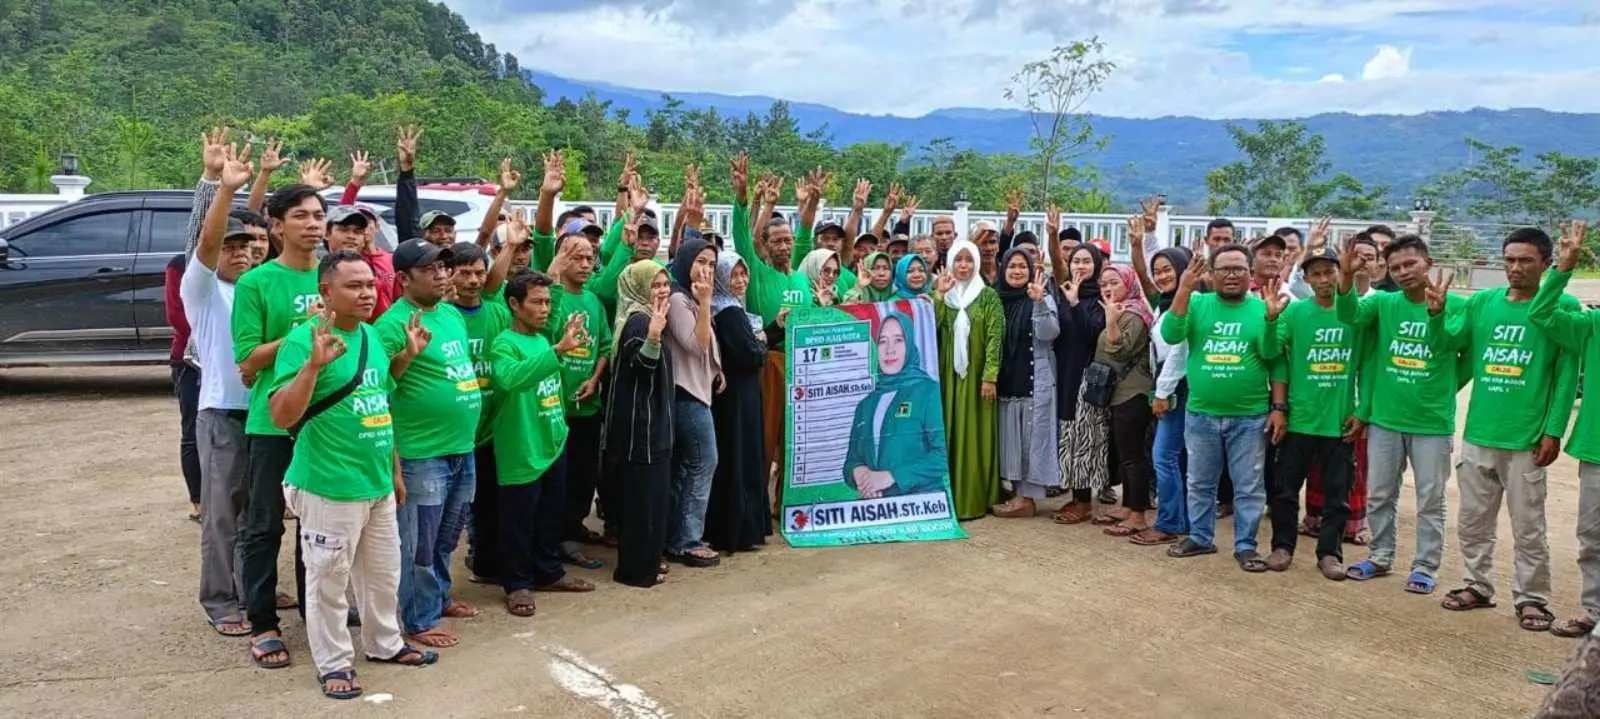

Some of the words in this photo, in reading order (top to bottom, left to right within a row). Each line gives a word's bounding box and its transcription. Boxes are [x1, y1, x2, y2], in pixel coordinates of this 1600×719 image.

[783, 290, 804, 304] SITI
[1213, 321, 1242, 336] SITI
[1315, 328, 1344, 343] SITI
[1398, 320, 1426, 337] SITI
[1493, 324, 1526, 342] SITI
[441, 340, 465, 358] SITI
[1202, 339, 1249, 354] AISAH
[803, 348, 818, 363] 17
[1306, 348, 1352, 362] AISAH
[1482, 346, 1533, 365] AISAH
[794, 387, 804, 400] 3
[808, 387, 824, 398] SITI
[815, 507, 845, 526] SITI
